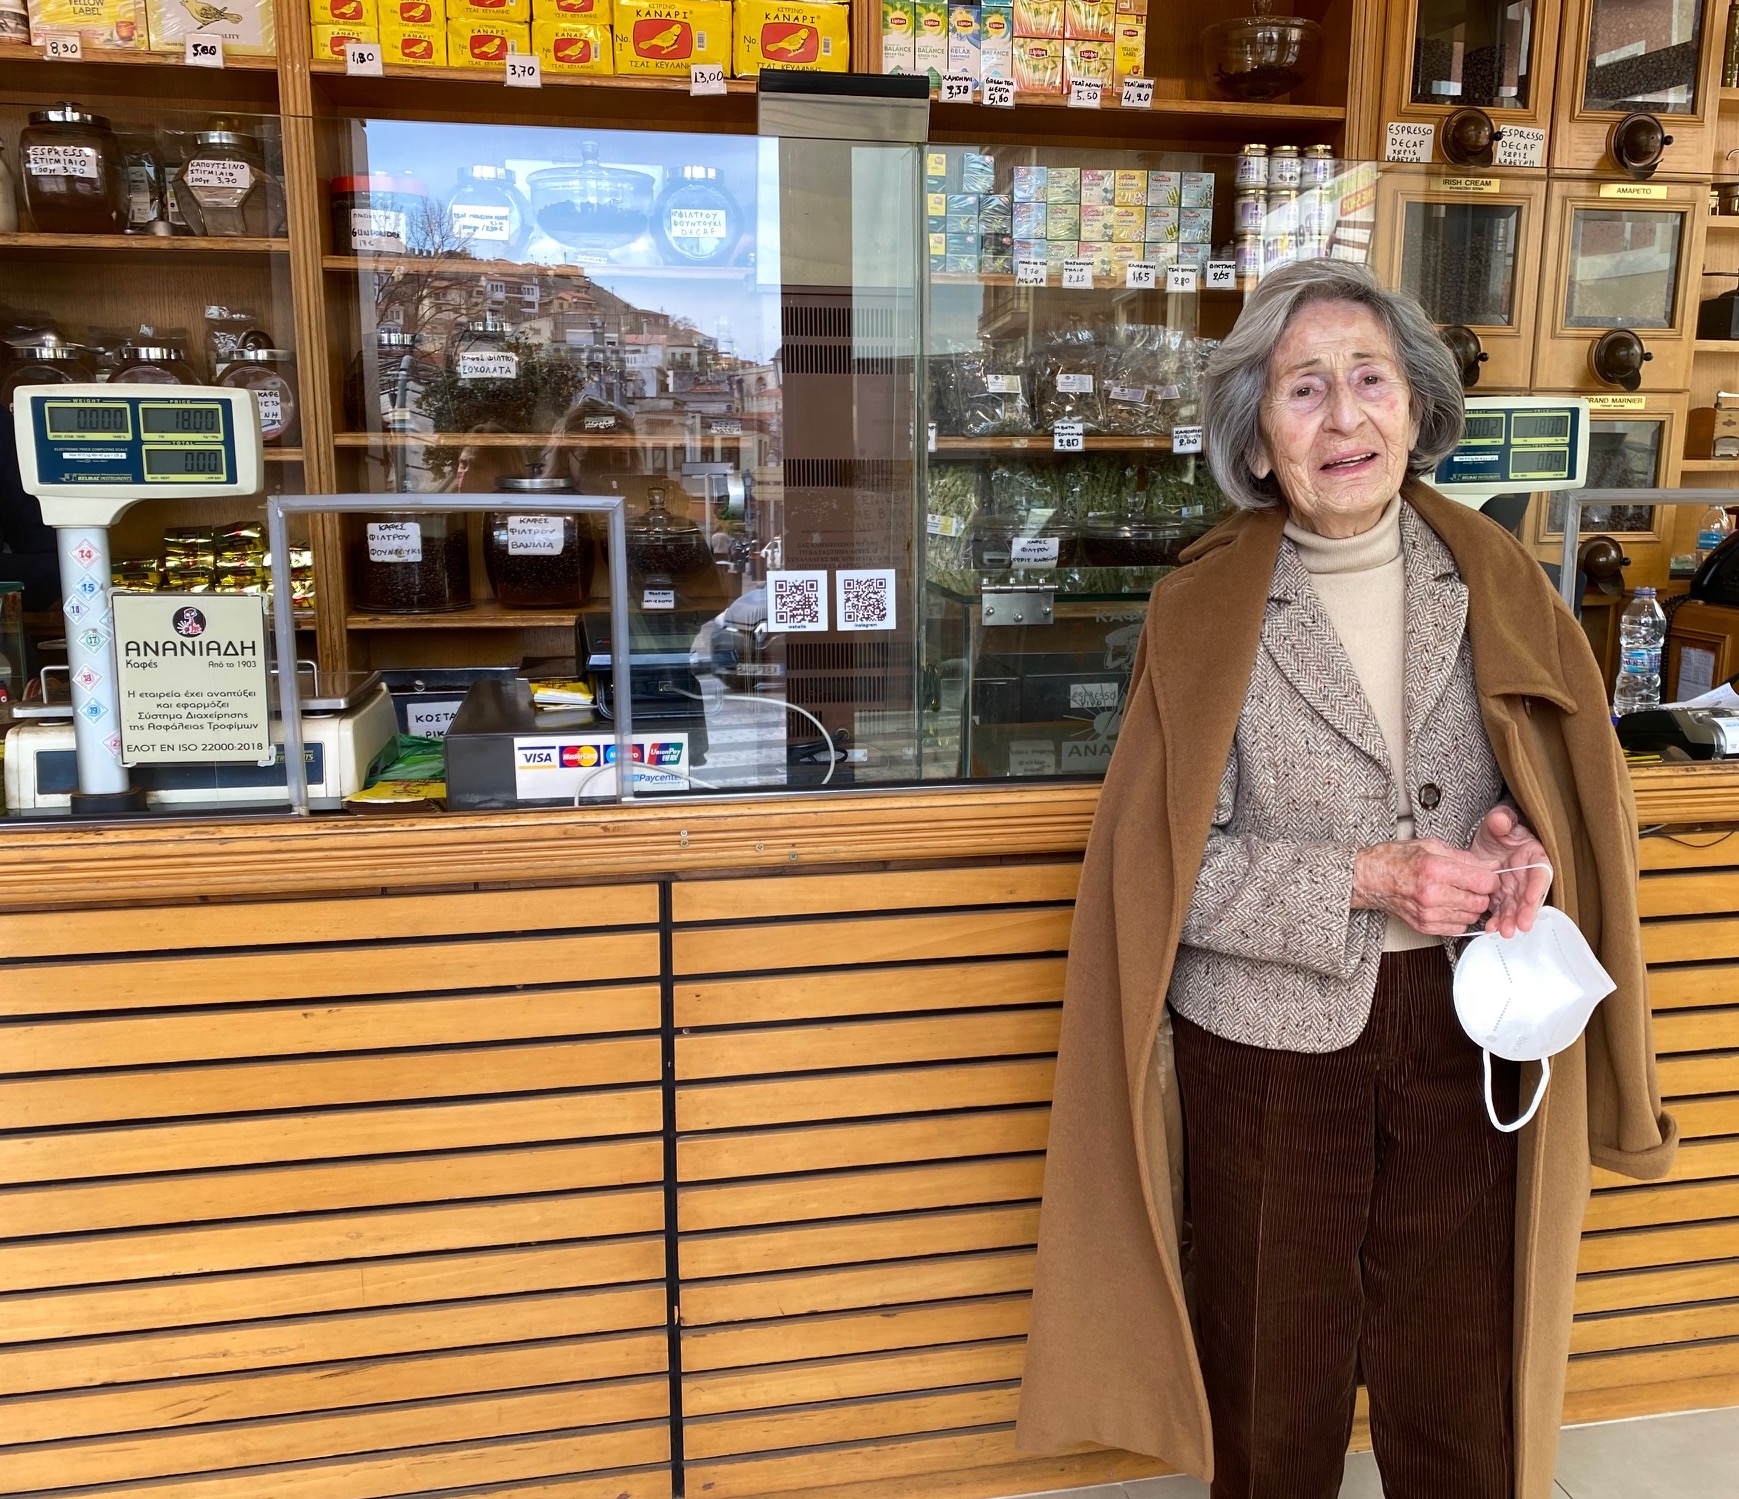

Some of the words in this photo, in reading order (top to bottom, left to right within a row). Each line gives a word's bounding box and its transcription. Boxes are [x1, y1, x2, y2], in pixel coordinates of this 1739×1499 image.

[73, 7, 102, 15] LABEL
[636, 10, 688, 19] ΚΑΝΑΡΙ
[765, 13, 816, 24] ΚΑΝΑΡΙ
[508, 64, 535, 78] 3,70
[1388, 124, 1433, 135] ESPRESSO
[1501, 127, 1544, 141] ESPRESSO
[1391, 138, 1425, 148] DECAF
[1501, 141, 1536, 151] DECAF
[190, 162, 245, 170] ΚΑΠΟΥΤΣΙΝΟ
[1465, 179, 1492, 187] CREAM
[369, 533, 410, 541] ΦΙΛΤΡΟΥ
[511, 541, 554, 549] ΒΑΝΙΛΙΑ
[78, 550, 93, 559] 14
[369, 547, 421, 556] ΦΟΥΝΤΟΥΚΙ
[81, 584, 95, 592] 15
[88, 636, 98, 645] 17
[125, 640, 256, 657] ΑΝΑΝΙΑΔΗ
[126, 659, 158, 670] Καφές
[208, 660, 224, 668] Από
[237, 660, 257, 668] 1903
[128, 690, 135, 698] Η
[139, 691, 181, 699] εταιρεία
[184, 690, 203, 698] έχει
[207, 689, 256, 698] αναπτύξει
[176, 701, 229, 709] εφαρμόζει
[89, 707, 98, 715] 19
[138, 712, 183, 721] Σύστημα
[148, 723, 204, 732] Ασφάλειας
[208, 721, 258, 731] Τροφίμων
[425, 731, 445, 739] ΡΙΚ
[161, 744, 175, 752] EN
[179, 743, 198, 751] ISO
[201, 743, 263, 751] 22000:2018
[523, 753, 552, 763] VISA
[563, 753, 598, 761] MasterCard
[650, 747, 682, 756] UnionPay
